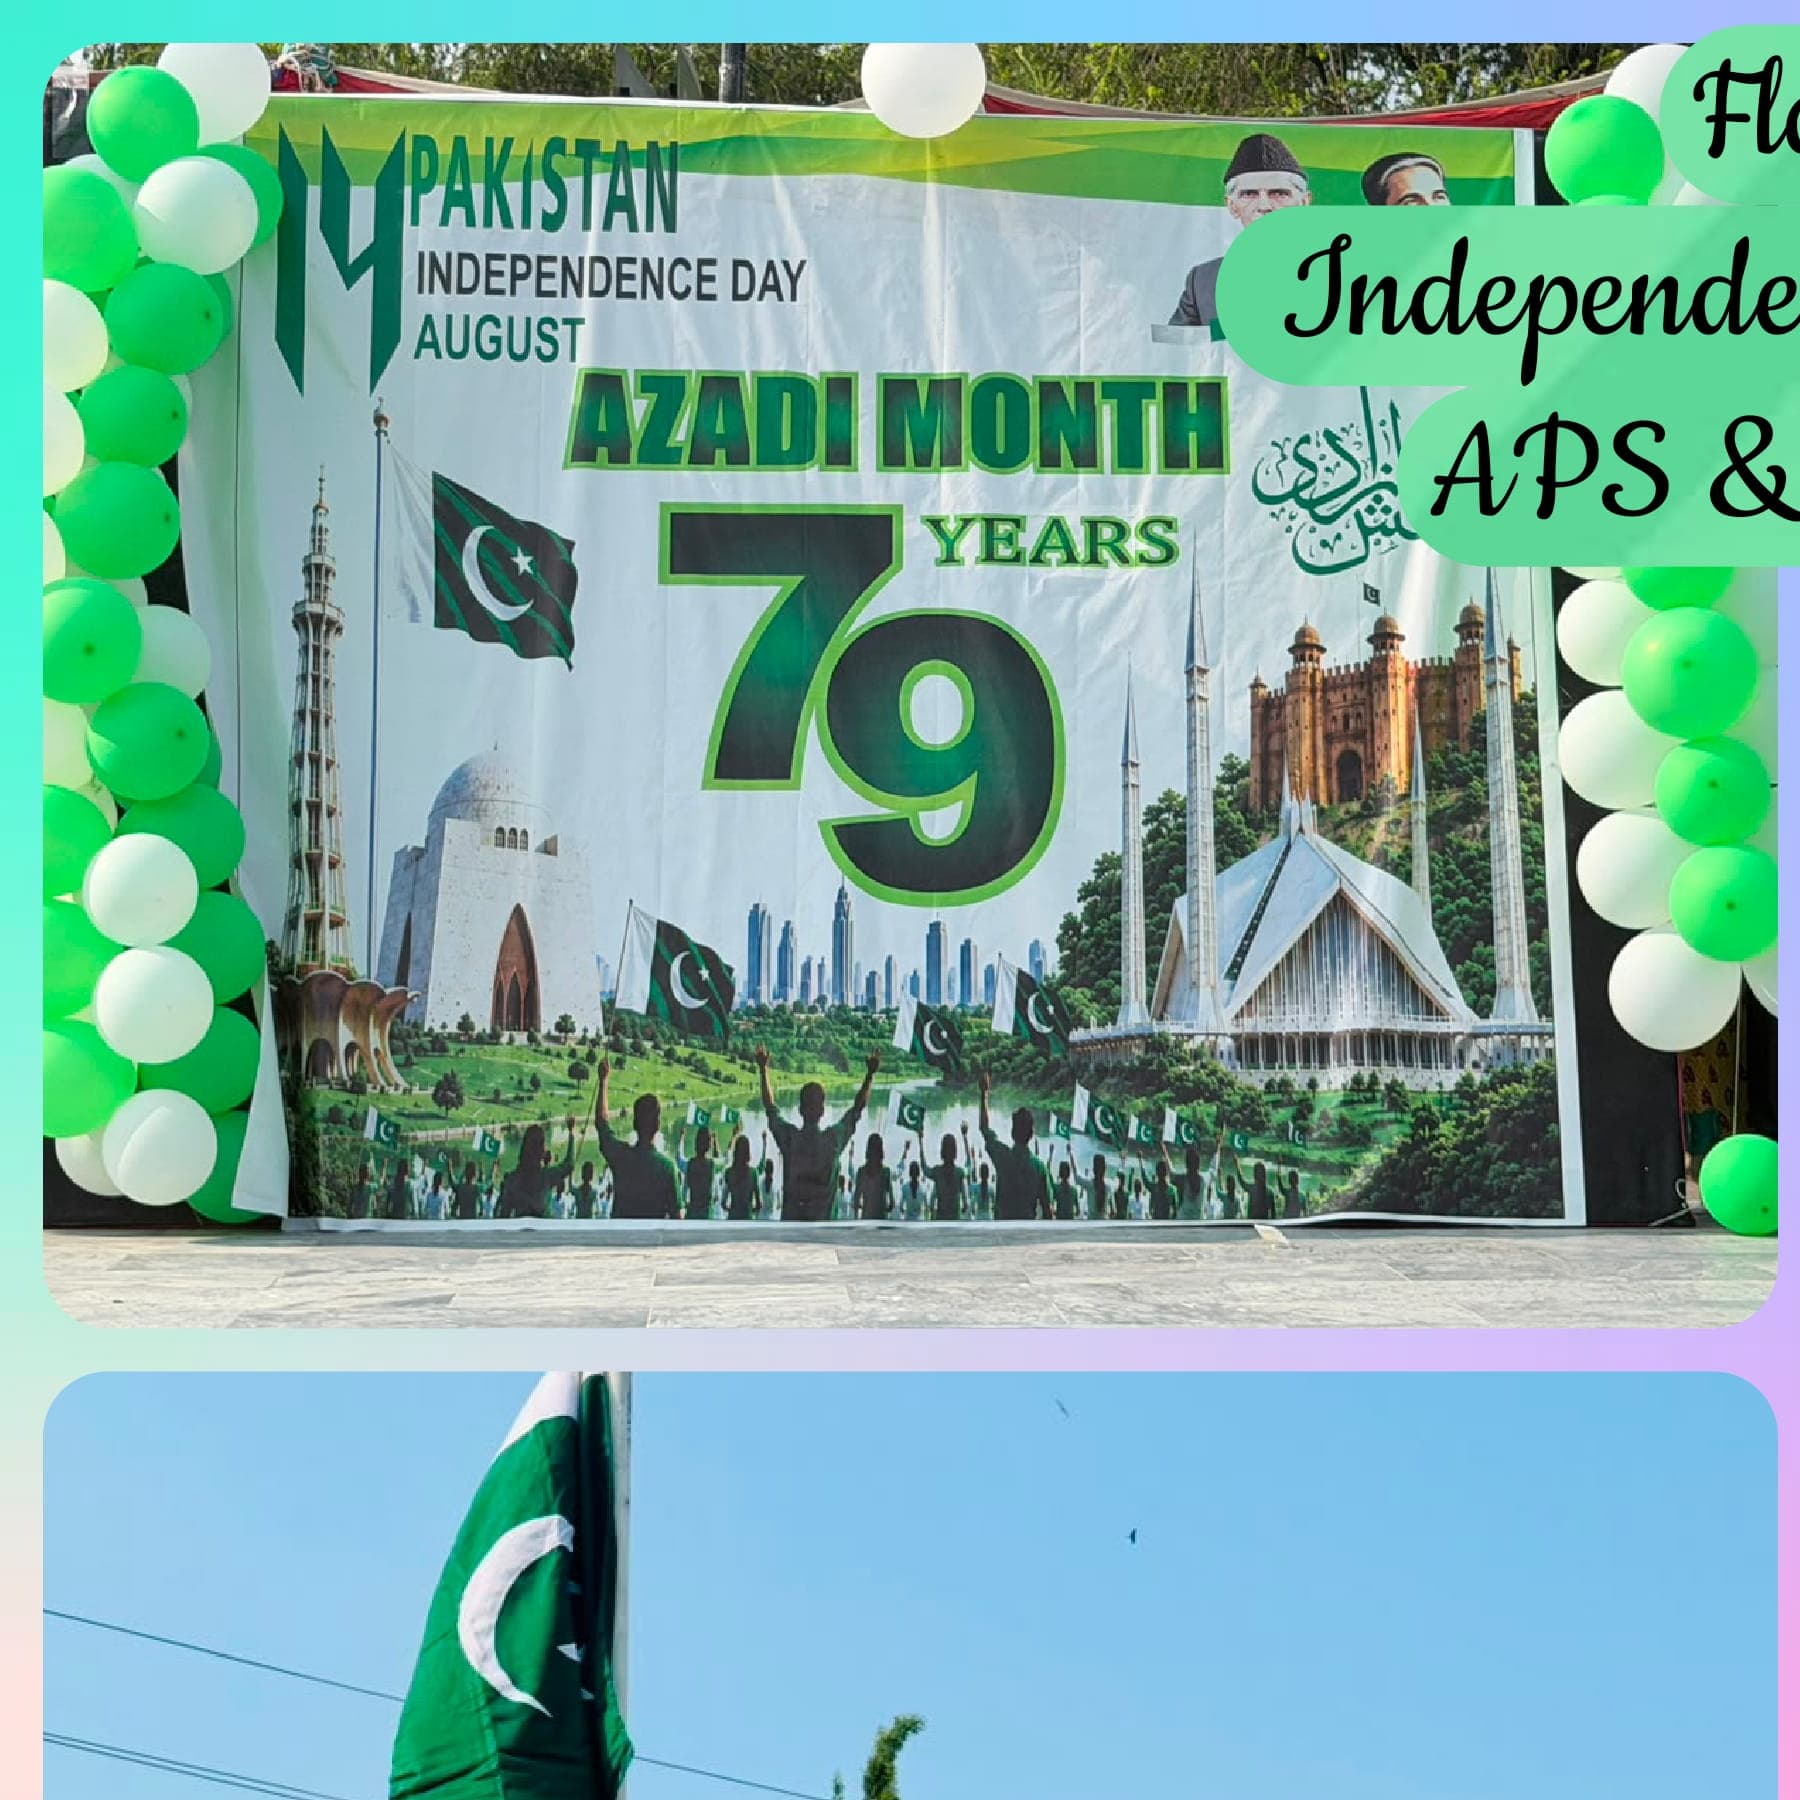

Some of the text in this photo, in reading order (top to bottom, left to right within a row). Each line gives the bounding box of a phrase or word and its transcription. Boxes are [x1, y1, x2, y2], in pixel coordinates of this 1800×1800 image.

[409, 134, 679, 233] PAKISTAN
[417, 251, 807, 303] INDEPENDENCE DAY
[413, 314, 586, 363] AUGUST
[562, 368, 1231, 475] AZADI MONTH
[923, 514, 1180, 568] YEARS
[658, 501, 1067, 907] 79
